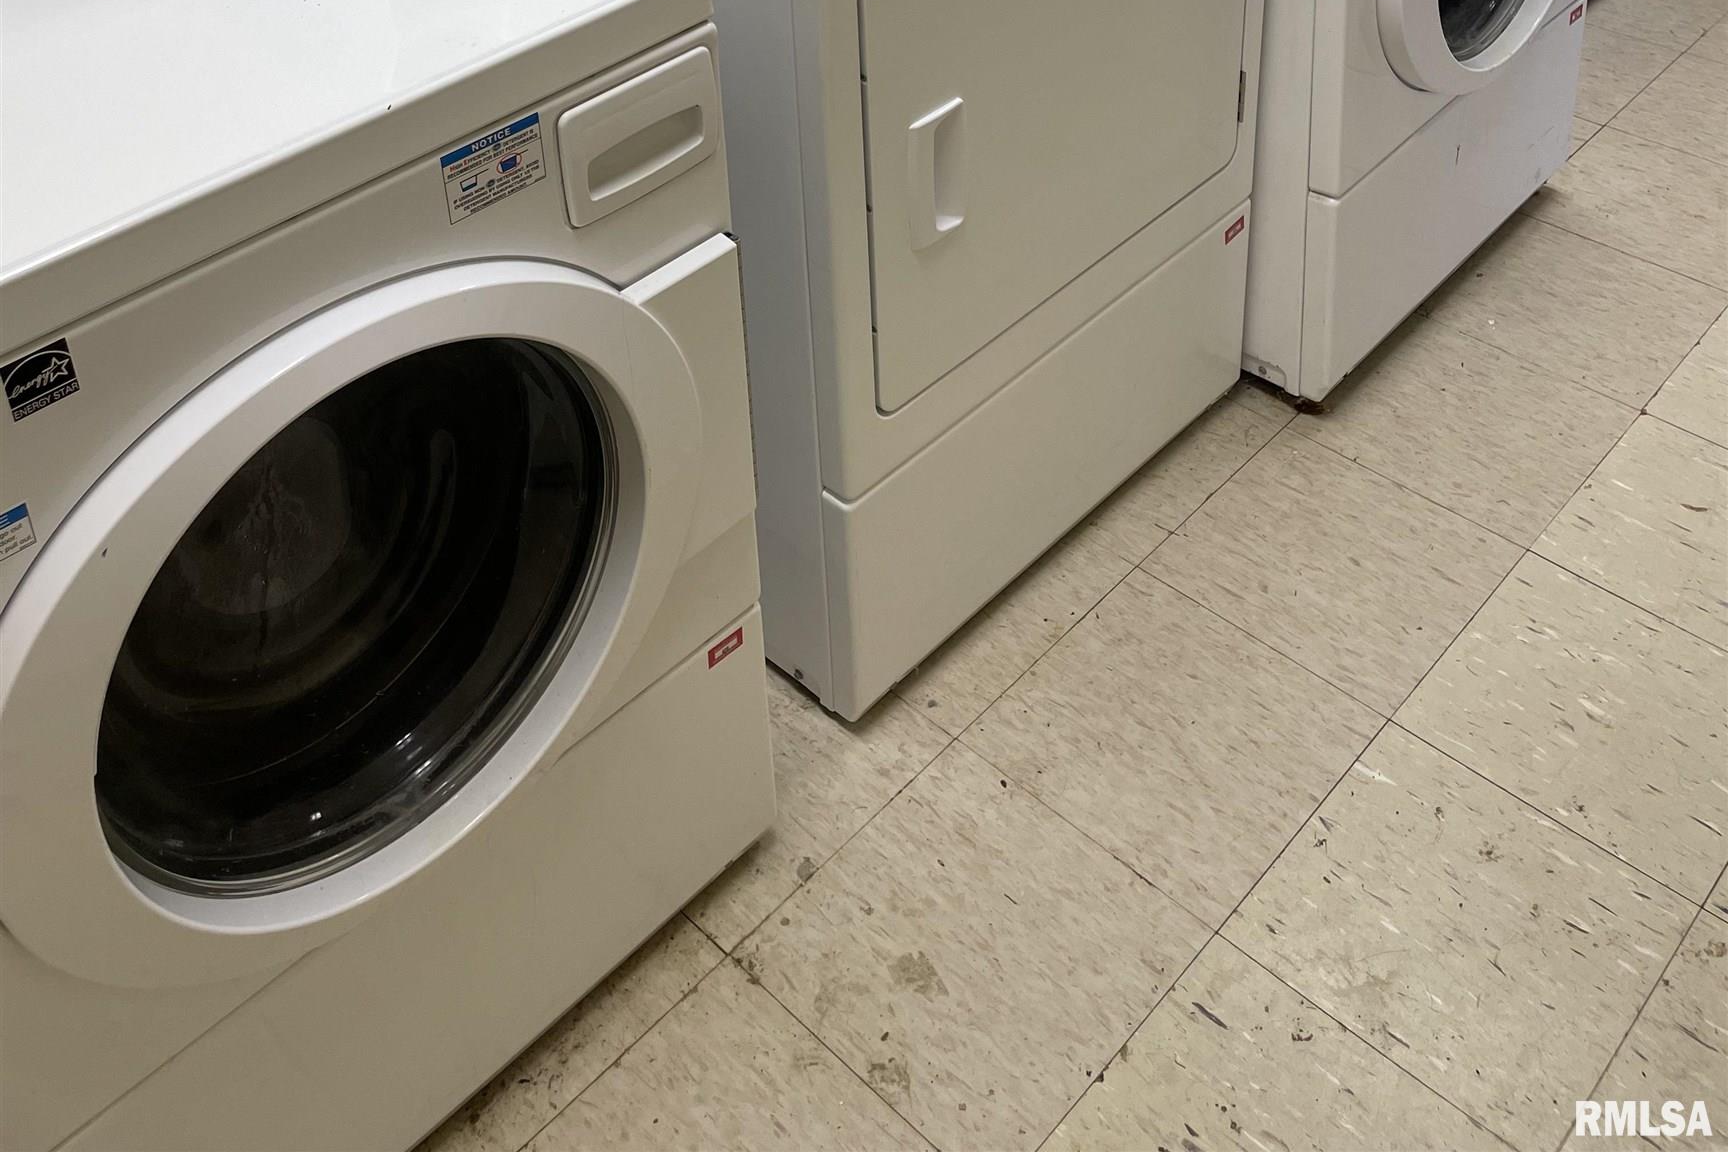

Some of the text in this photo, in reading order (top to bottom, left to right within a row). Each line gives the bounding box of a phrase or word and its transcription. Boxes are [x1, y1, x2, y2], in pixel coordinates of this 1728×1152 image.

[471, 128, 512, 152] NOTICE
[14, 382, 79, 420] ENERGY STAR
